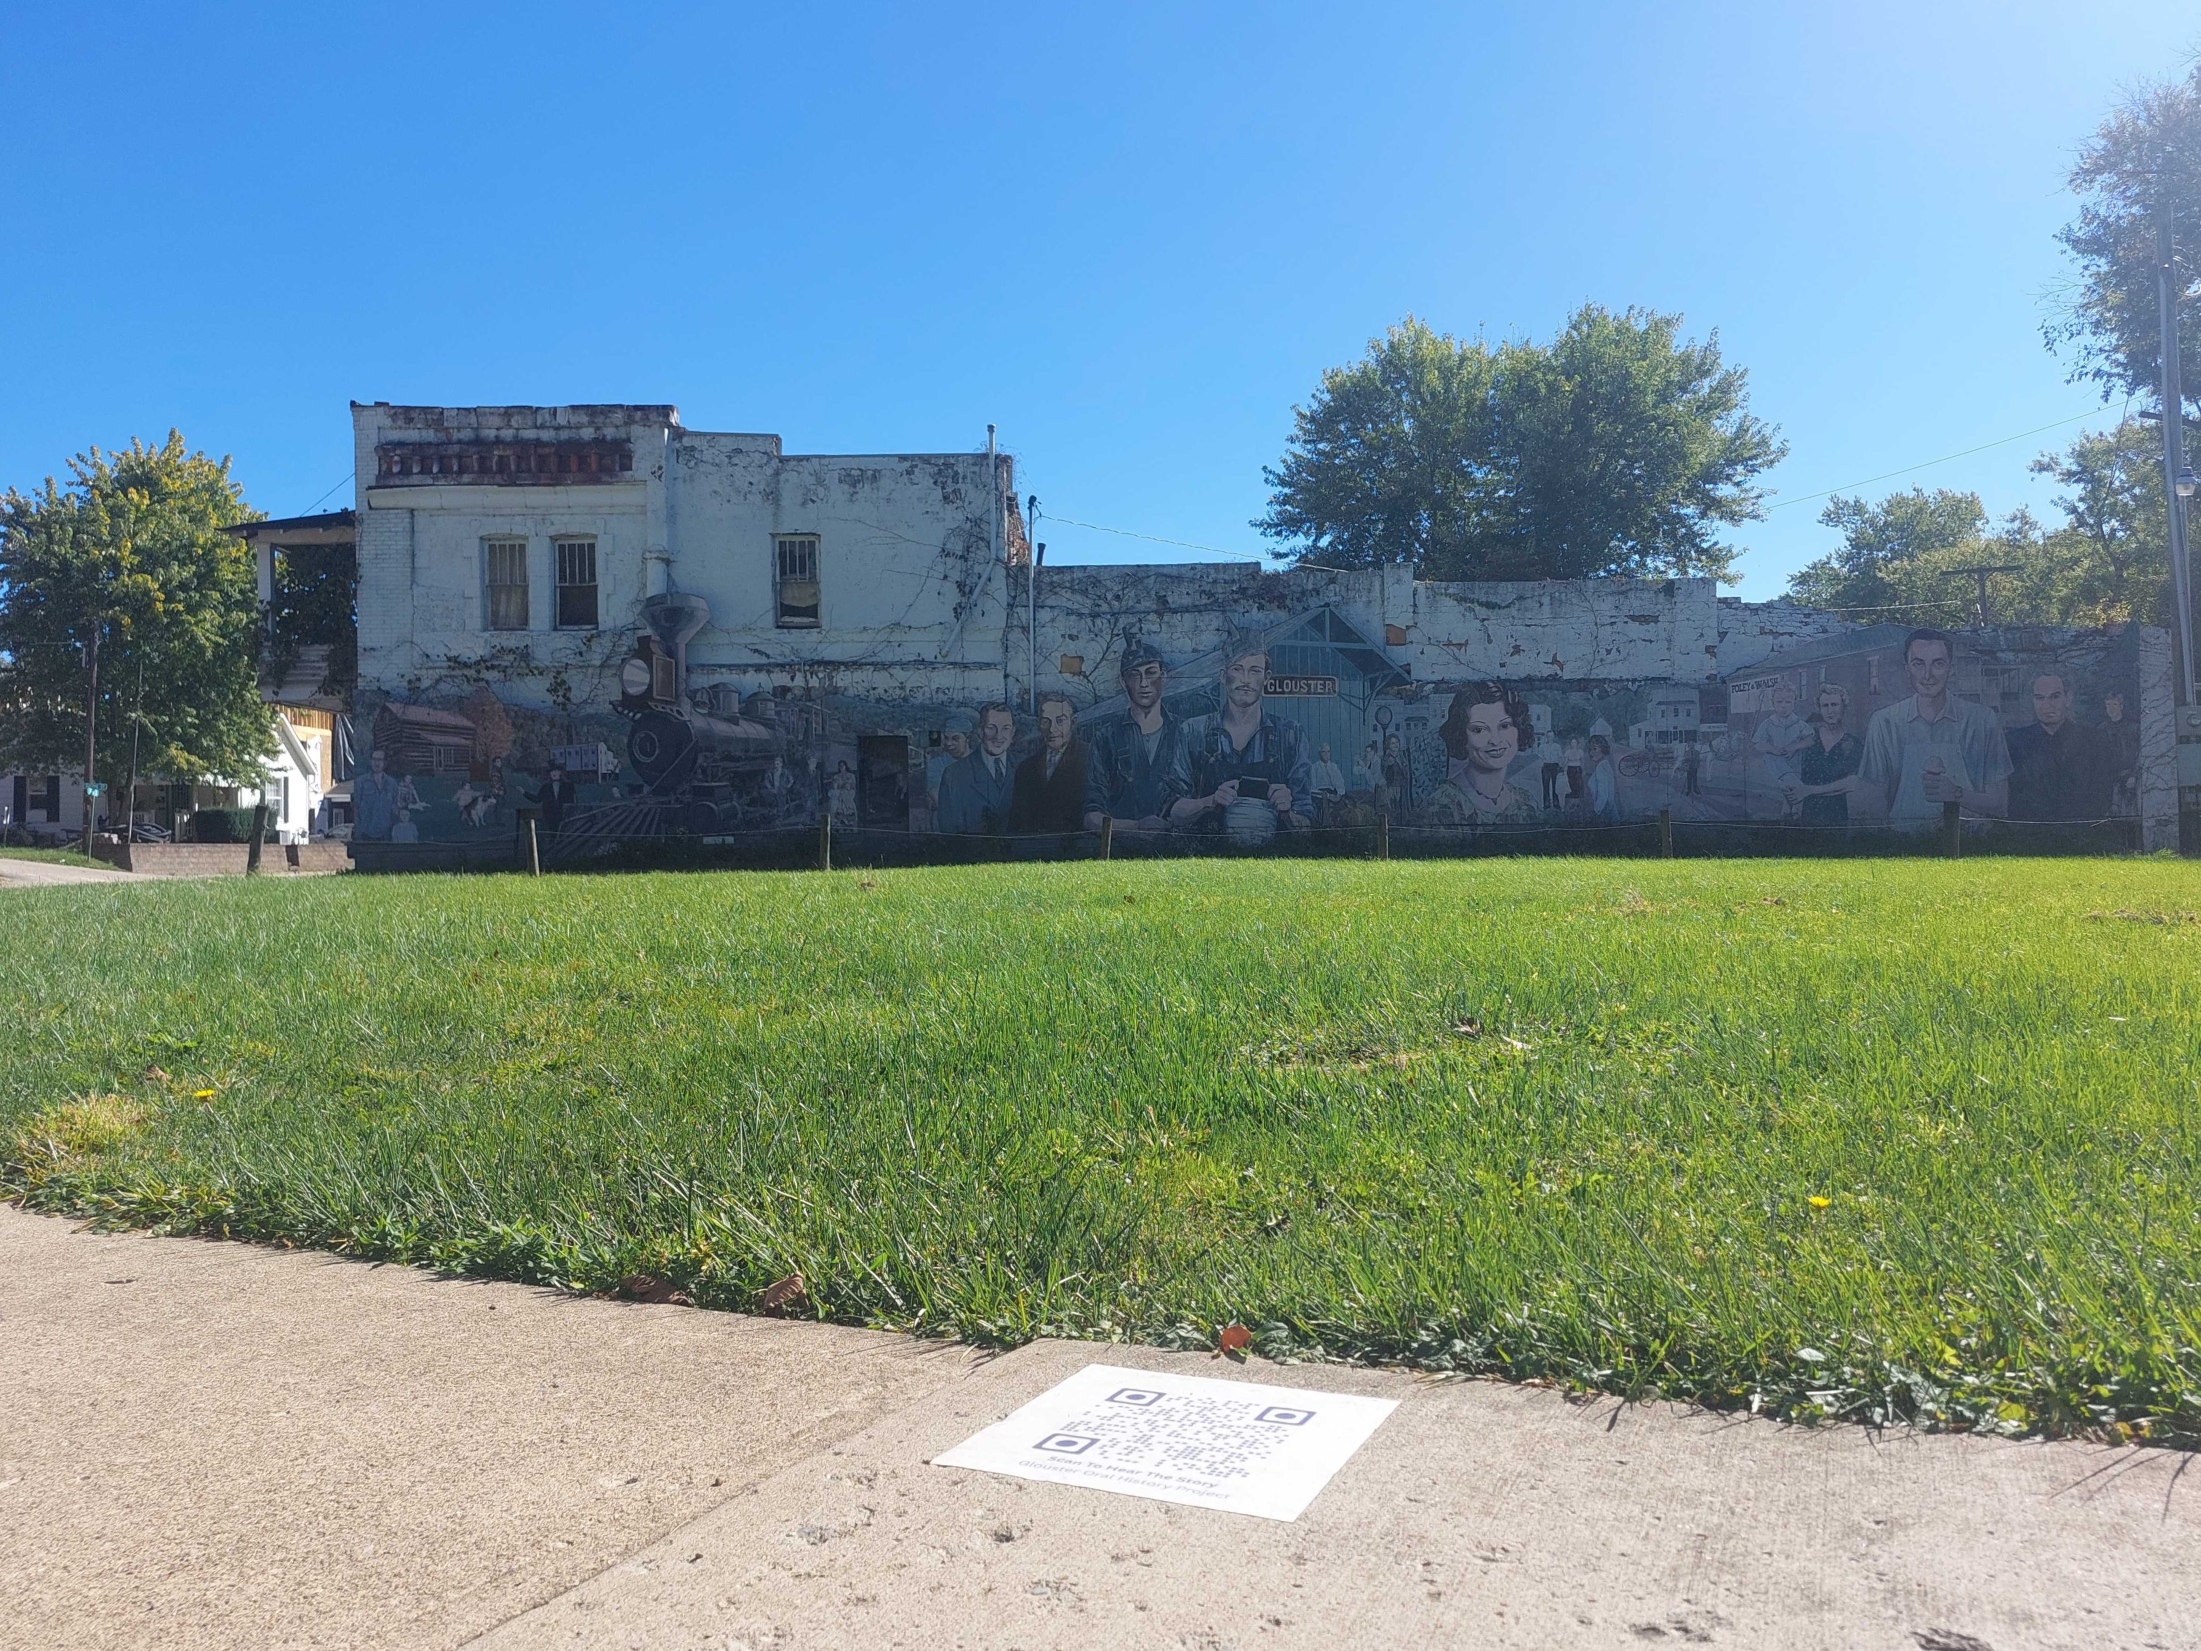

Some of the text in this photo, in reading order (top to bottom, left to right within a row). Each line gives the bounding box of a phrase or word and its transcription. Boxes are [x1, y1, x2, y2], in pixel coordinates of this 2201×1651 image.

[1267, 679, 1334, 693] GLOUSTER
[1731, 682, 1751, 694] FOLEY
[1018, 1460, 1232, 1500] Glouster Oral History Project
[1047, 1456, 1220, 1489] Scan To Hear The Story
